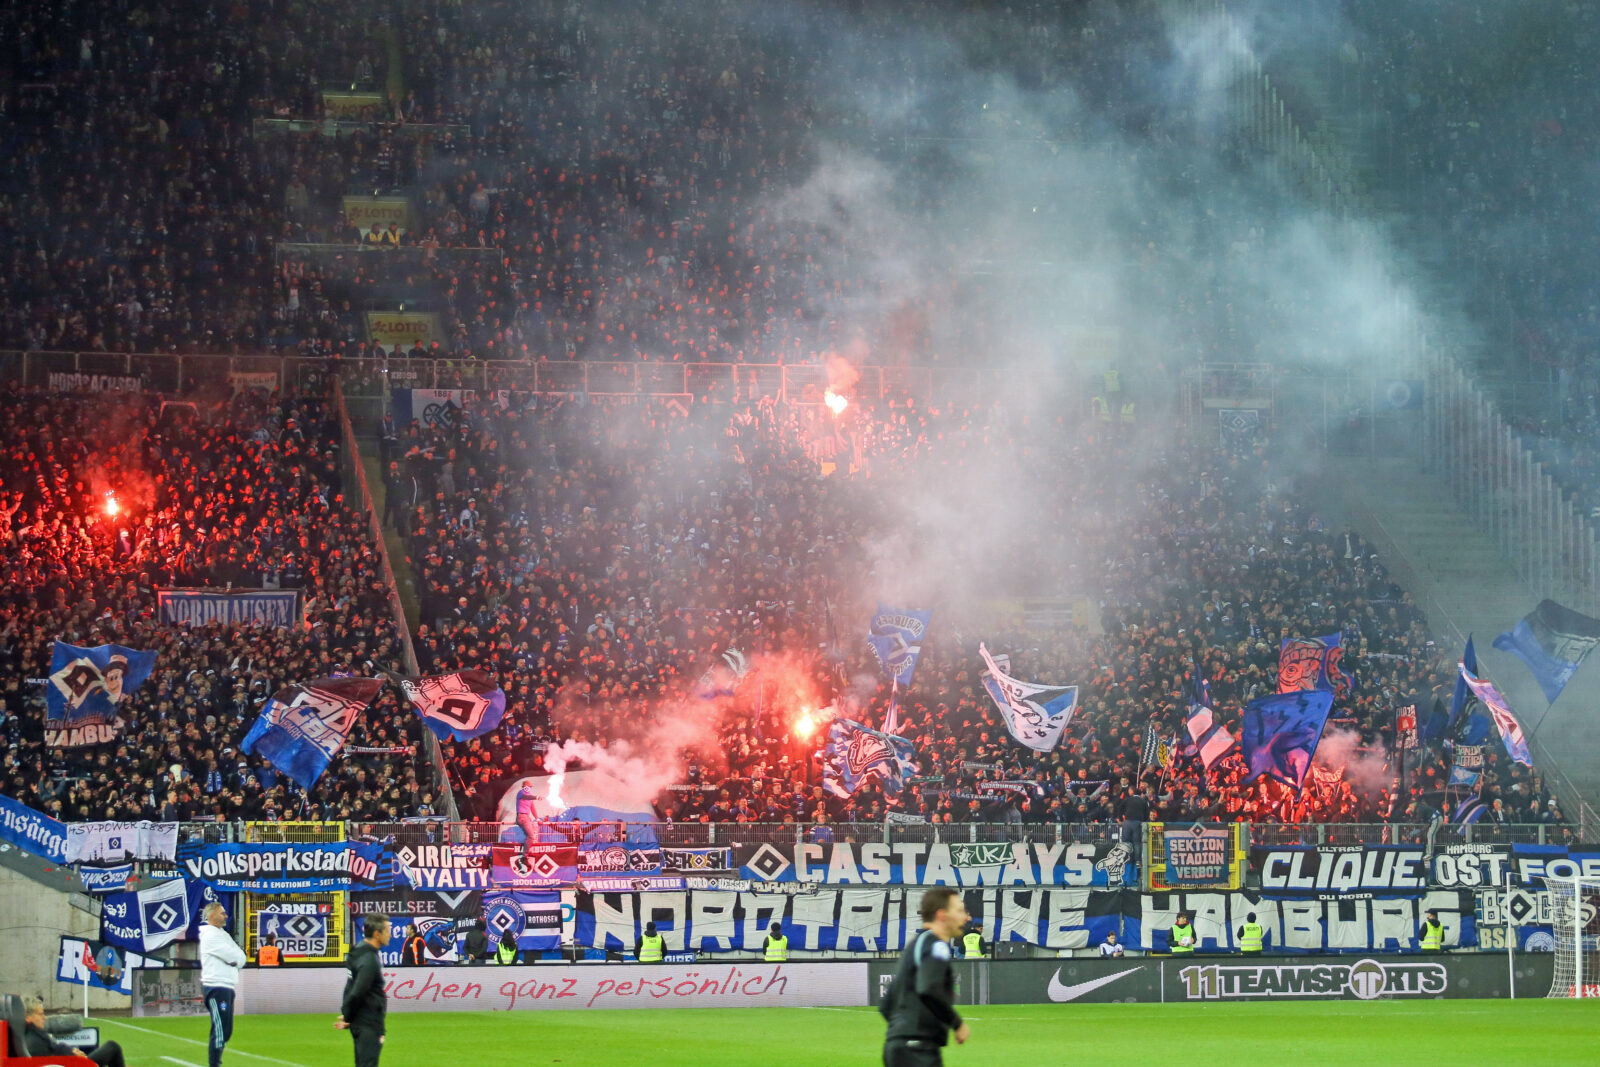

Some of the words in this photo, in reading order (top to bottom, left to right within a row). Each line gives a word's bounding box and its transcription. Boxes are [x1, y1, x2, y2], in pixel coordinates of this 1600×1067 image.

[365, 208, 402, 218] LOTTO
[388, 321, 428, 333] LOTTO
[167, 599, 290, 629] NORDHAUSEN
[44, 724, 118, 747] HAMBU
[140, 823, 177, 835] 1887
[1169, 838, 1225, 852] SEKTION
[1446, 844, 1492, 854] HAMBURG
[185, 847, 378, 882] Volksparkstadion
[1170, 852, 1225, 866] STADION
[1175, 865, 1222, 879] VERBOT
[1435, 853, 1508, 887] OST
[270, 880, 311, 888] EMOTIONEN
[416, 867, 489, 888] YALTY
[350, 900, 438, 914] DIEMELSEE
[528, 914, 559, 924] ROTHOSEN
[1140, 887, 1461, 951] HAMBURG
[1479, 927, 1518, 949] BSA
[499, 977, 578, 1011] ganz
[587, 965, 789, 1008] persönlich
